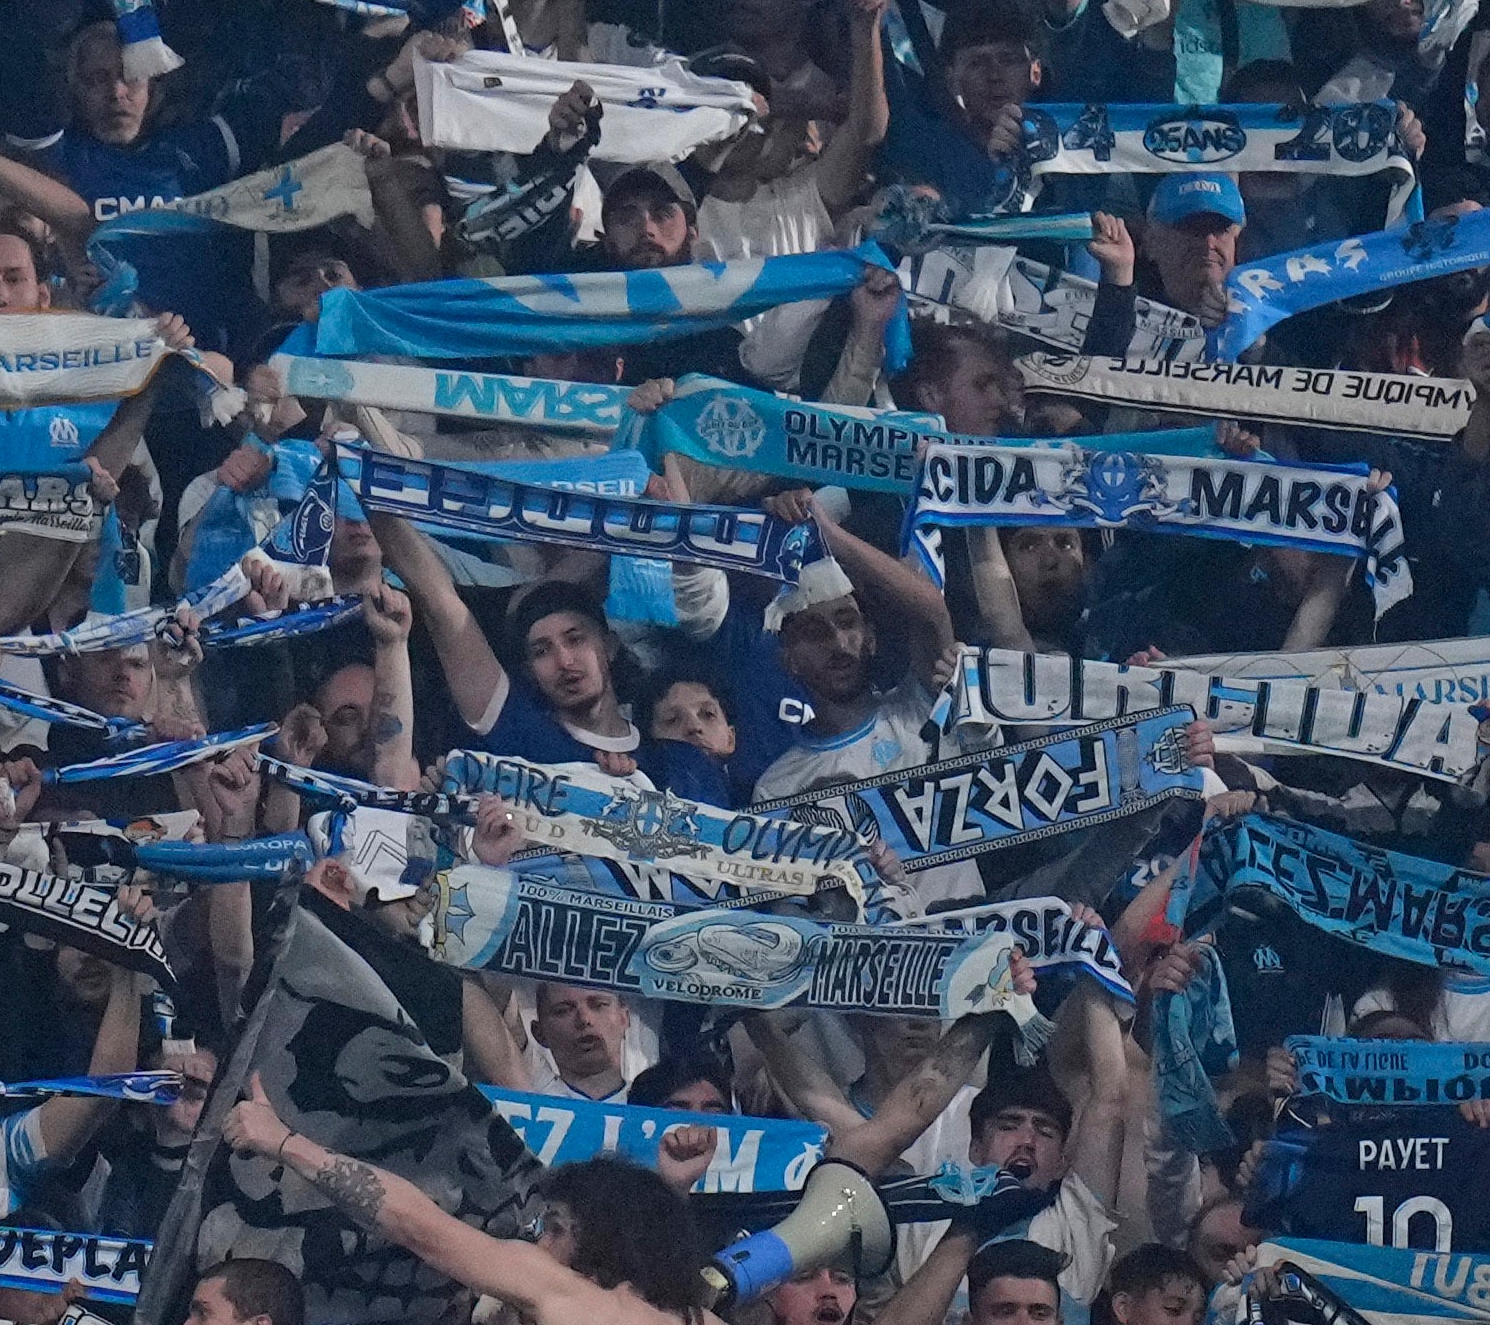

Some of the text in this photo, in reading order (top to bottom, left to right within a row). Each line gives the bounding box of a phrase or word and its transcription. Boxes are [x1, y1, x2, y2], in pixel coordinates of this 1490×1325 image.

[505, 894, 953, 1008] ALLEZ MARSEILLE
[653, 975, 763, 1002] VELODROME
[1358, 1138, 1452, 1173] PAYET
[1353, 1194, 1454, 1255] 10
